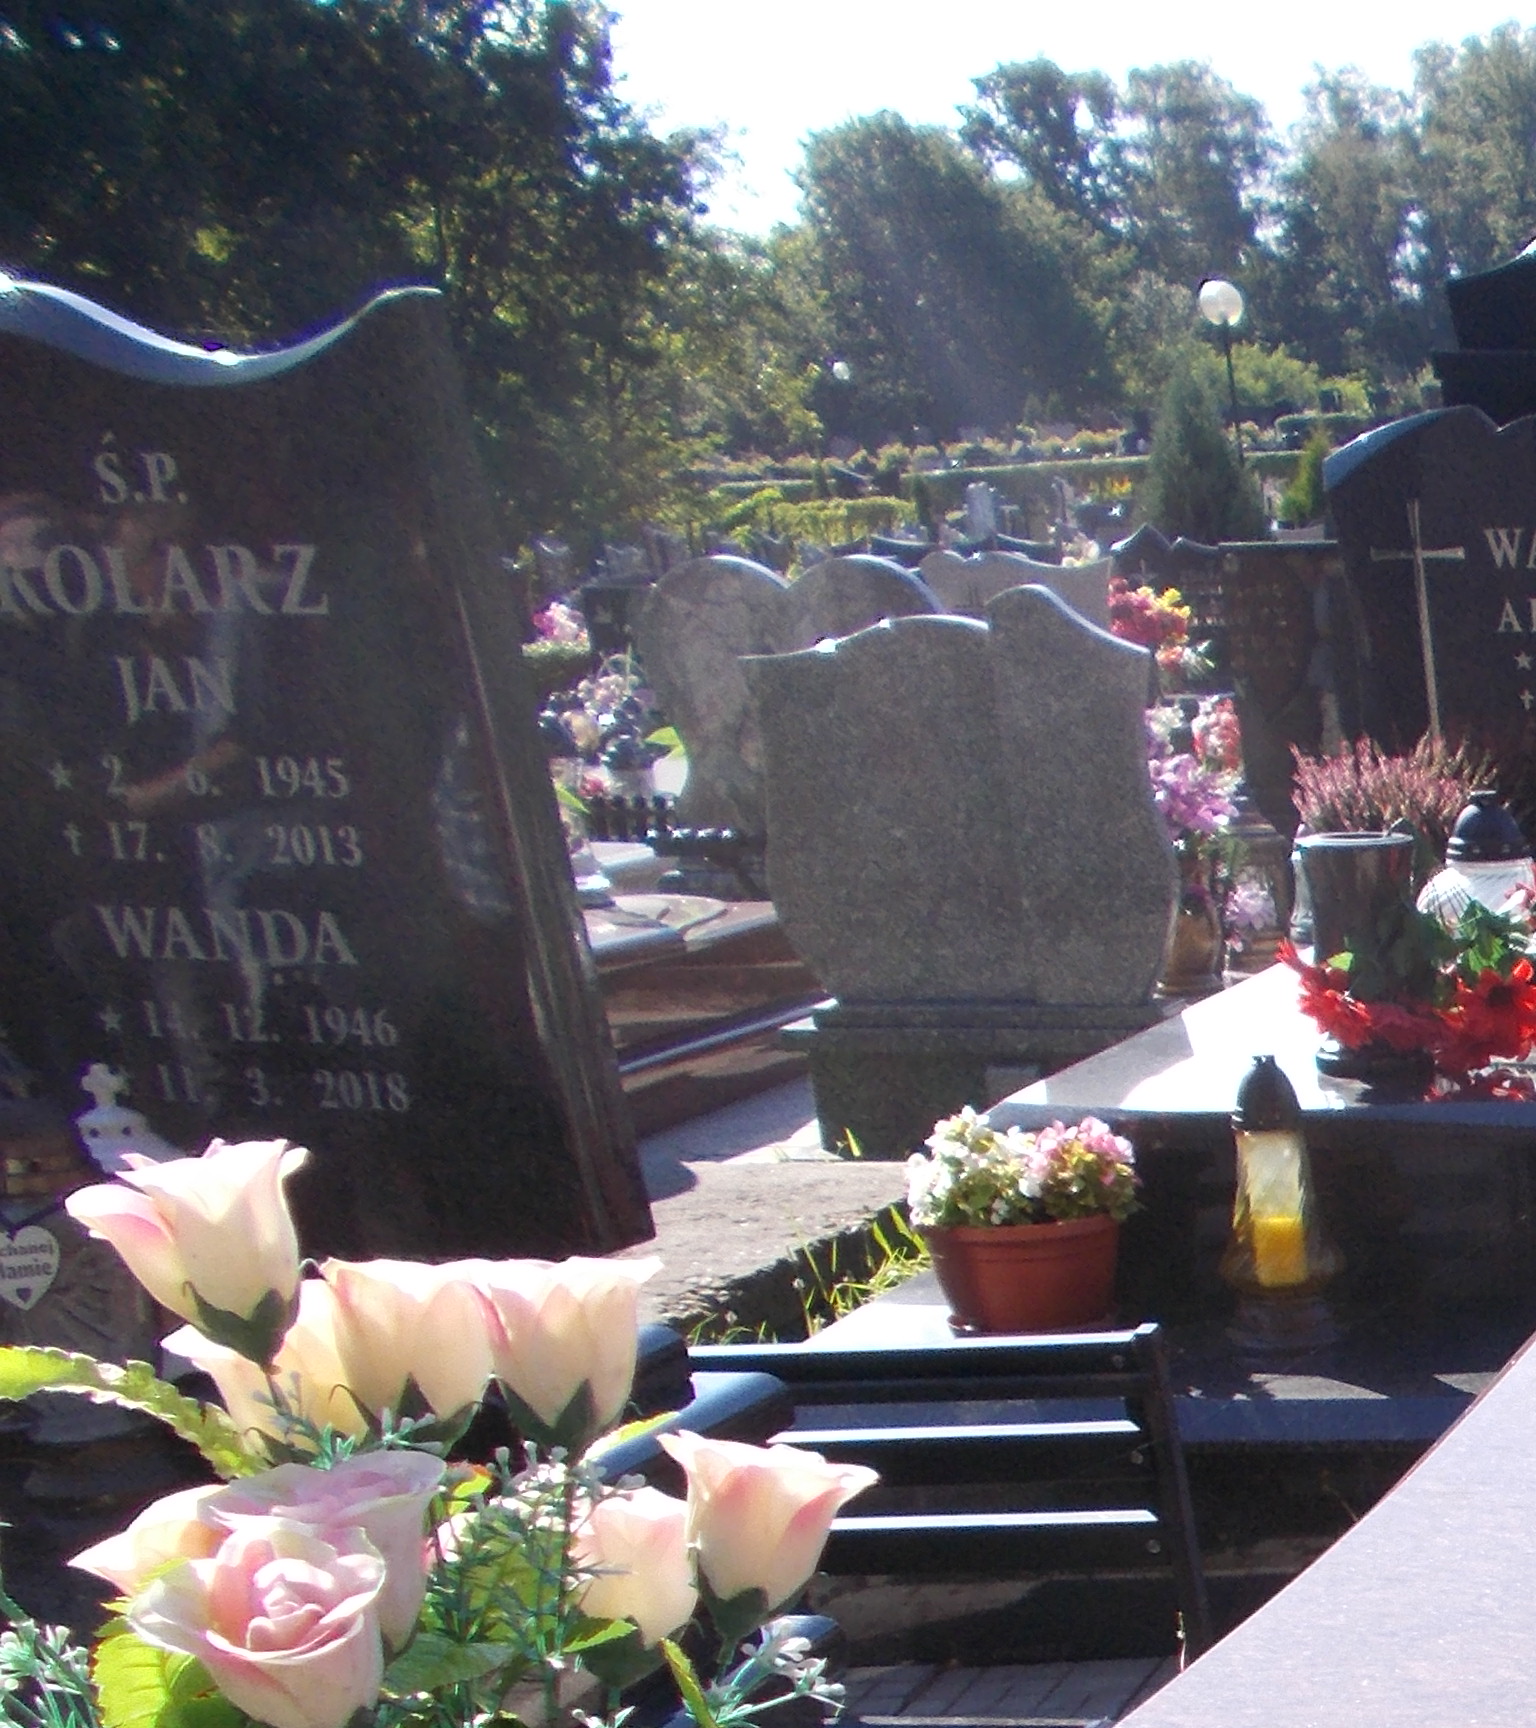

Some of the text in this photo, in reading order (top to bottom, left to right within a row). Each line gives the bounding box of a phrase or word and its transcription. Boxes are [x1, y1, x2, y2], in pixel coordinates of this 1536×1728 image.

[117, 656, 236, 724] JAN
[255, 756, 350, 799] 1945
[265, 825, 362, 868] 2013
[94, 904, 358, 966] WANDA
[302, 1004, 397, 1046] 1946
[313, 1068, 411, 1113] 2018
